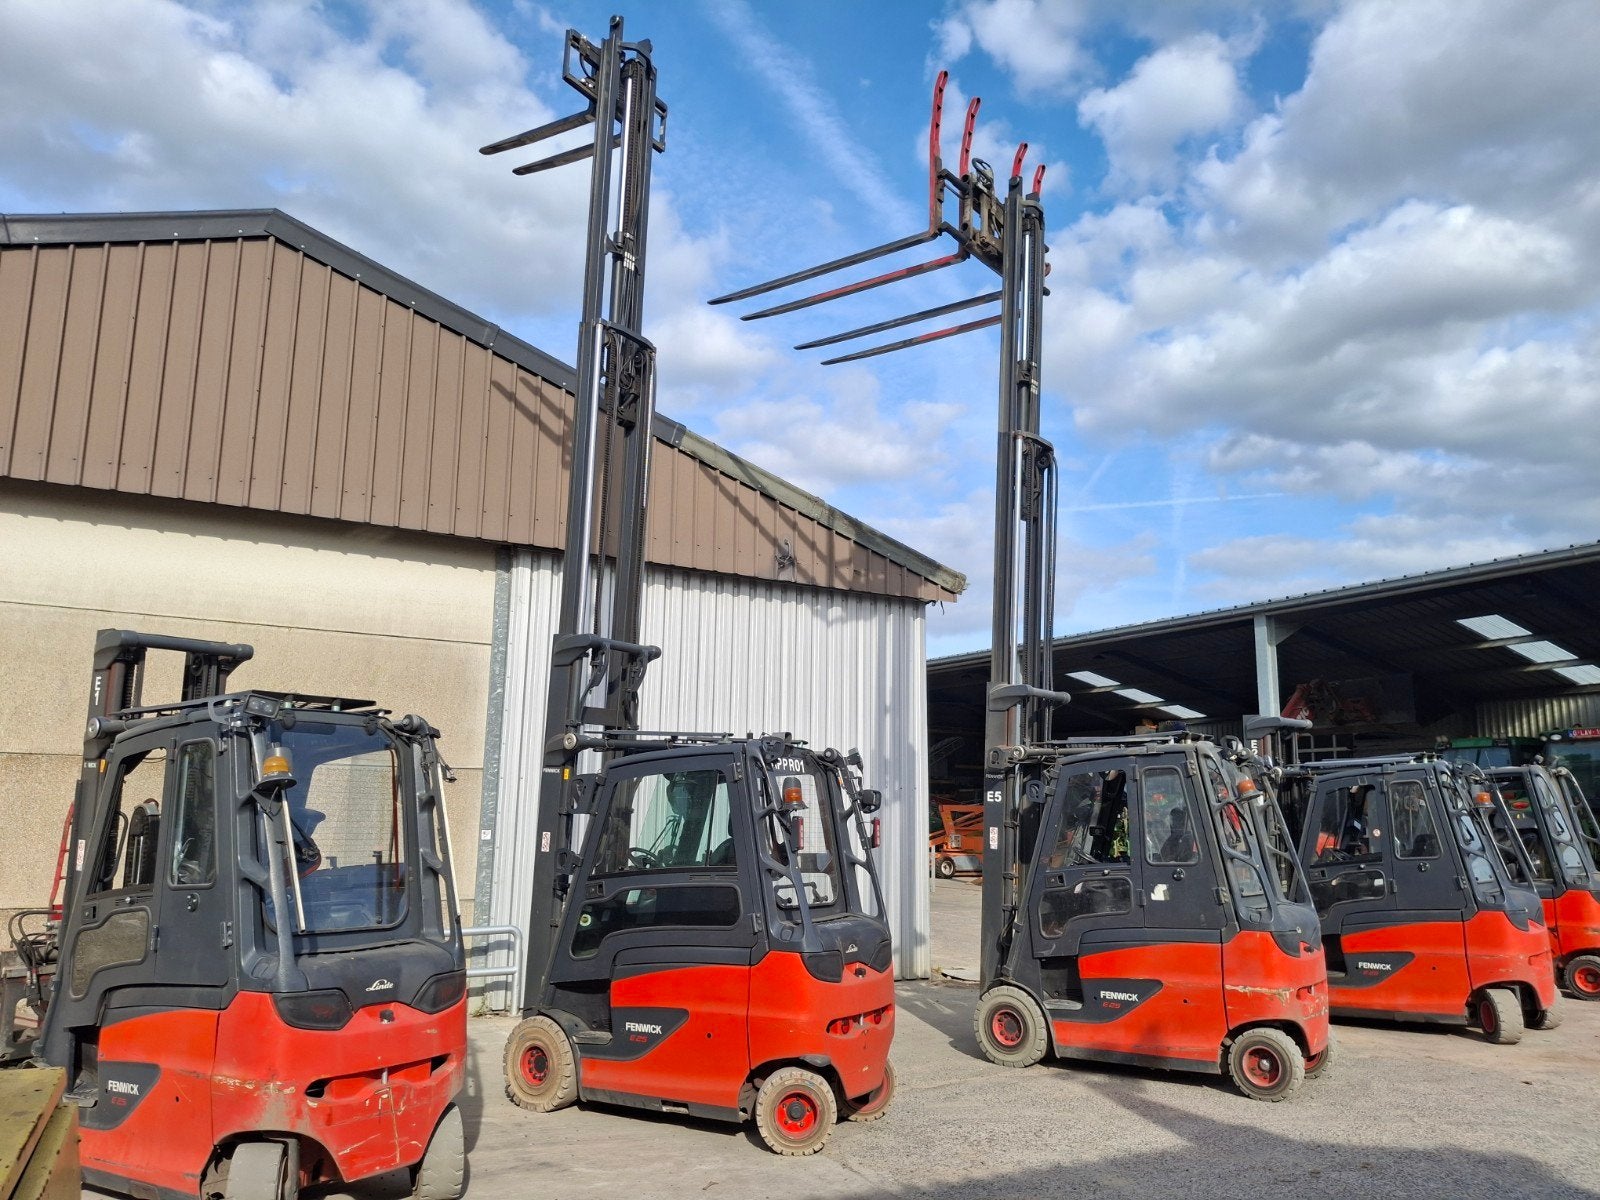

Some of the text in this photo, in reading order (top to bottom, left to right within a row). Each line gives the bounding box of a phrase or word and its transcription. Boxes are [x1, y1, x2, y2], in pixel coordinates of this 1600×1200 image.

[987, 790, 1002, 802] E5
[1358, 961, 1392, 970] FENWICK
[365, 978, 394, 991] Linde
[1100, 990, 1139, 1001] FENWICK
[625, 1021, 662, 1034] FENWICK
[108, 1079, 140, 1096] FENWICK
